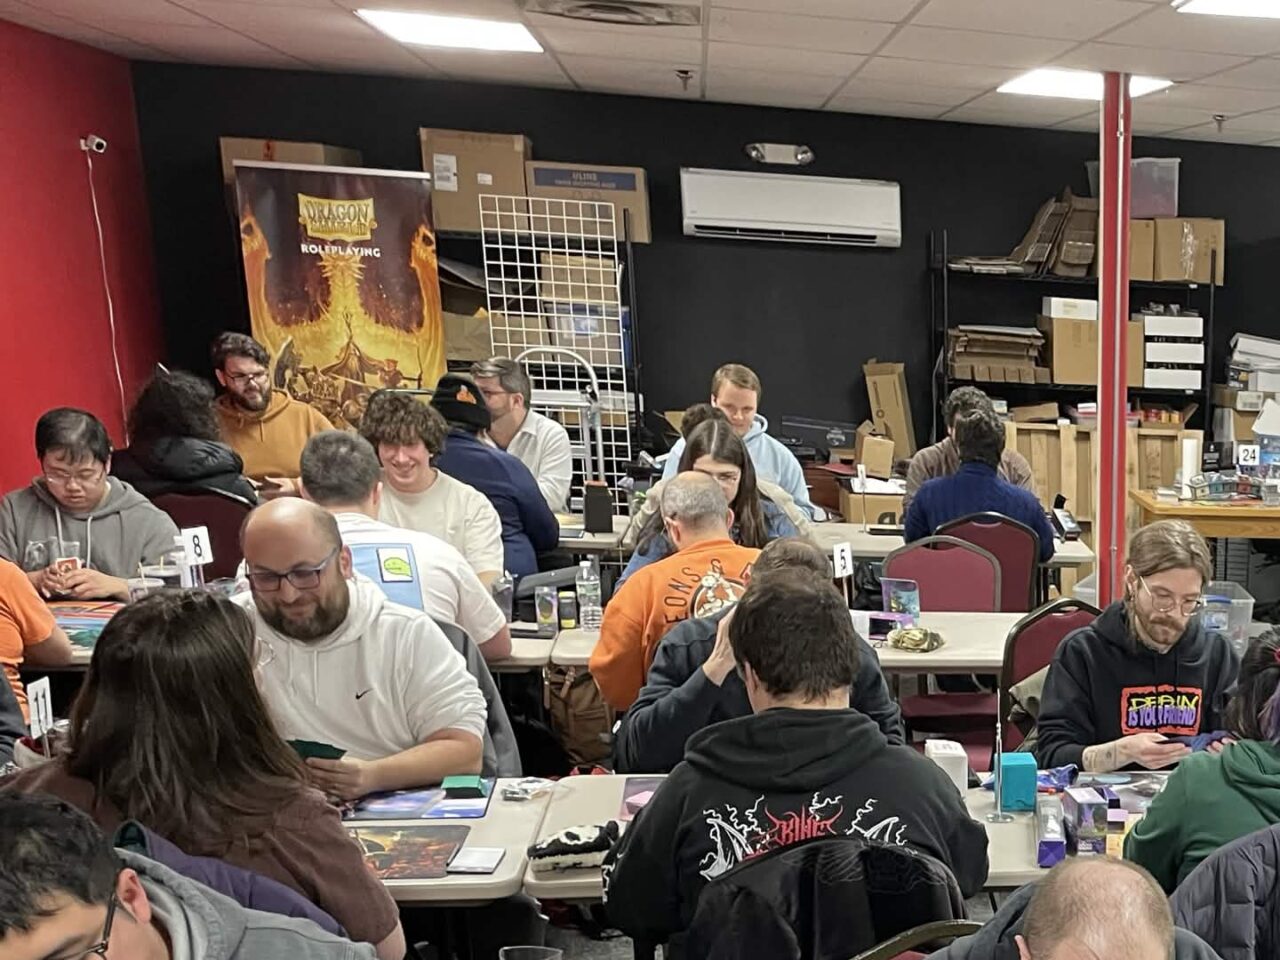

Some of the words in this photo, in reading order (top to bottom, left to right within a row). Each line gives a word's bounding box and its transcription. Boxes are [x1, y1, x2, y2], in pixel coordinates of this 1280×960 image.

[304, 200, 370, 222] DRAGON
[300, 243, 381, 258] ROLEPLAYING
[1242, 449, 1256, 462] 24
[193, 535, 202, 557] 8
[840, 549, 847, 570] 5
[34, 688, 48, 725] 11
